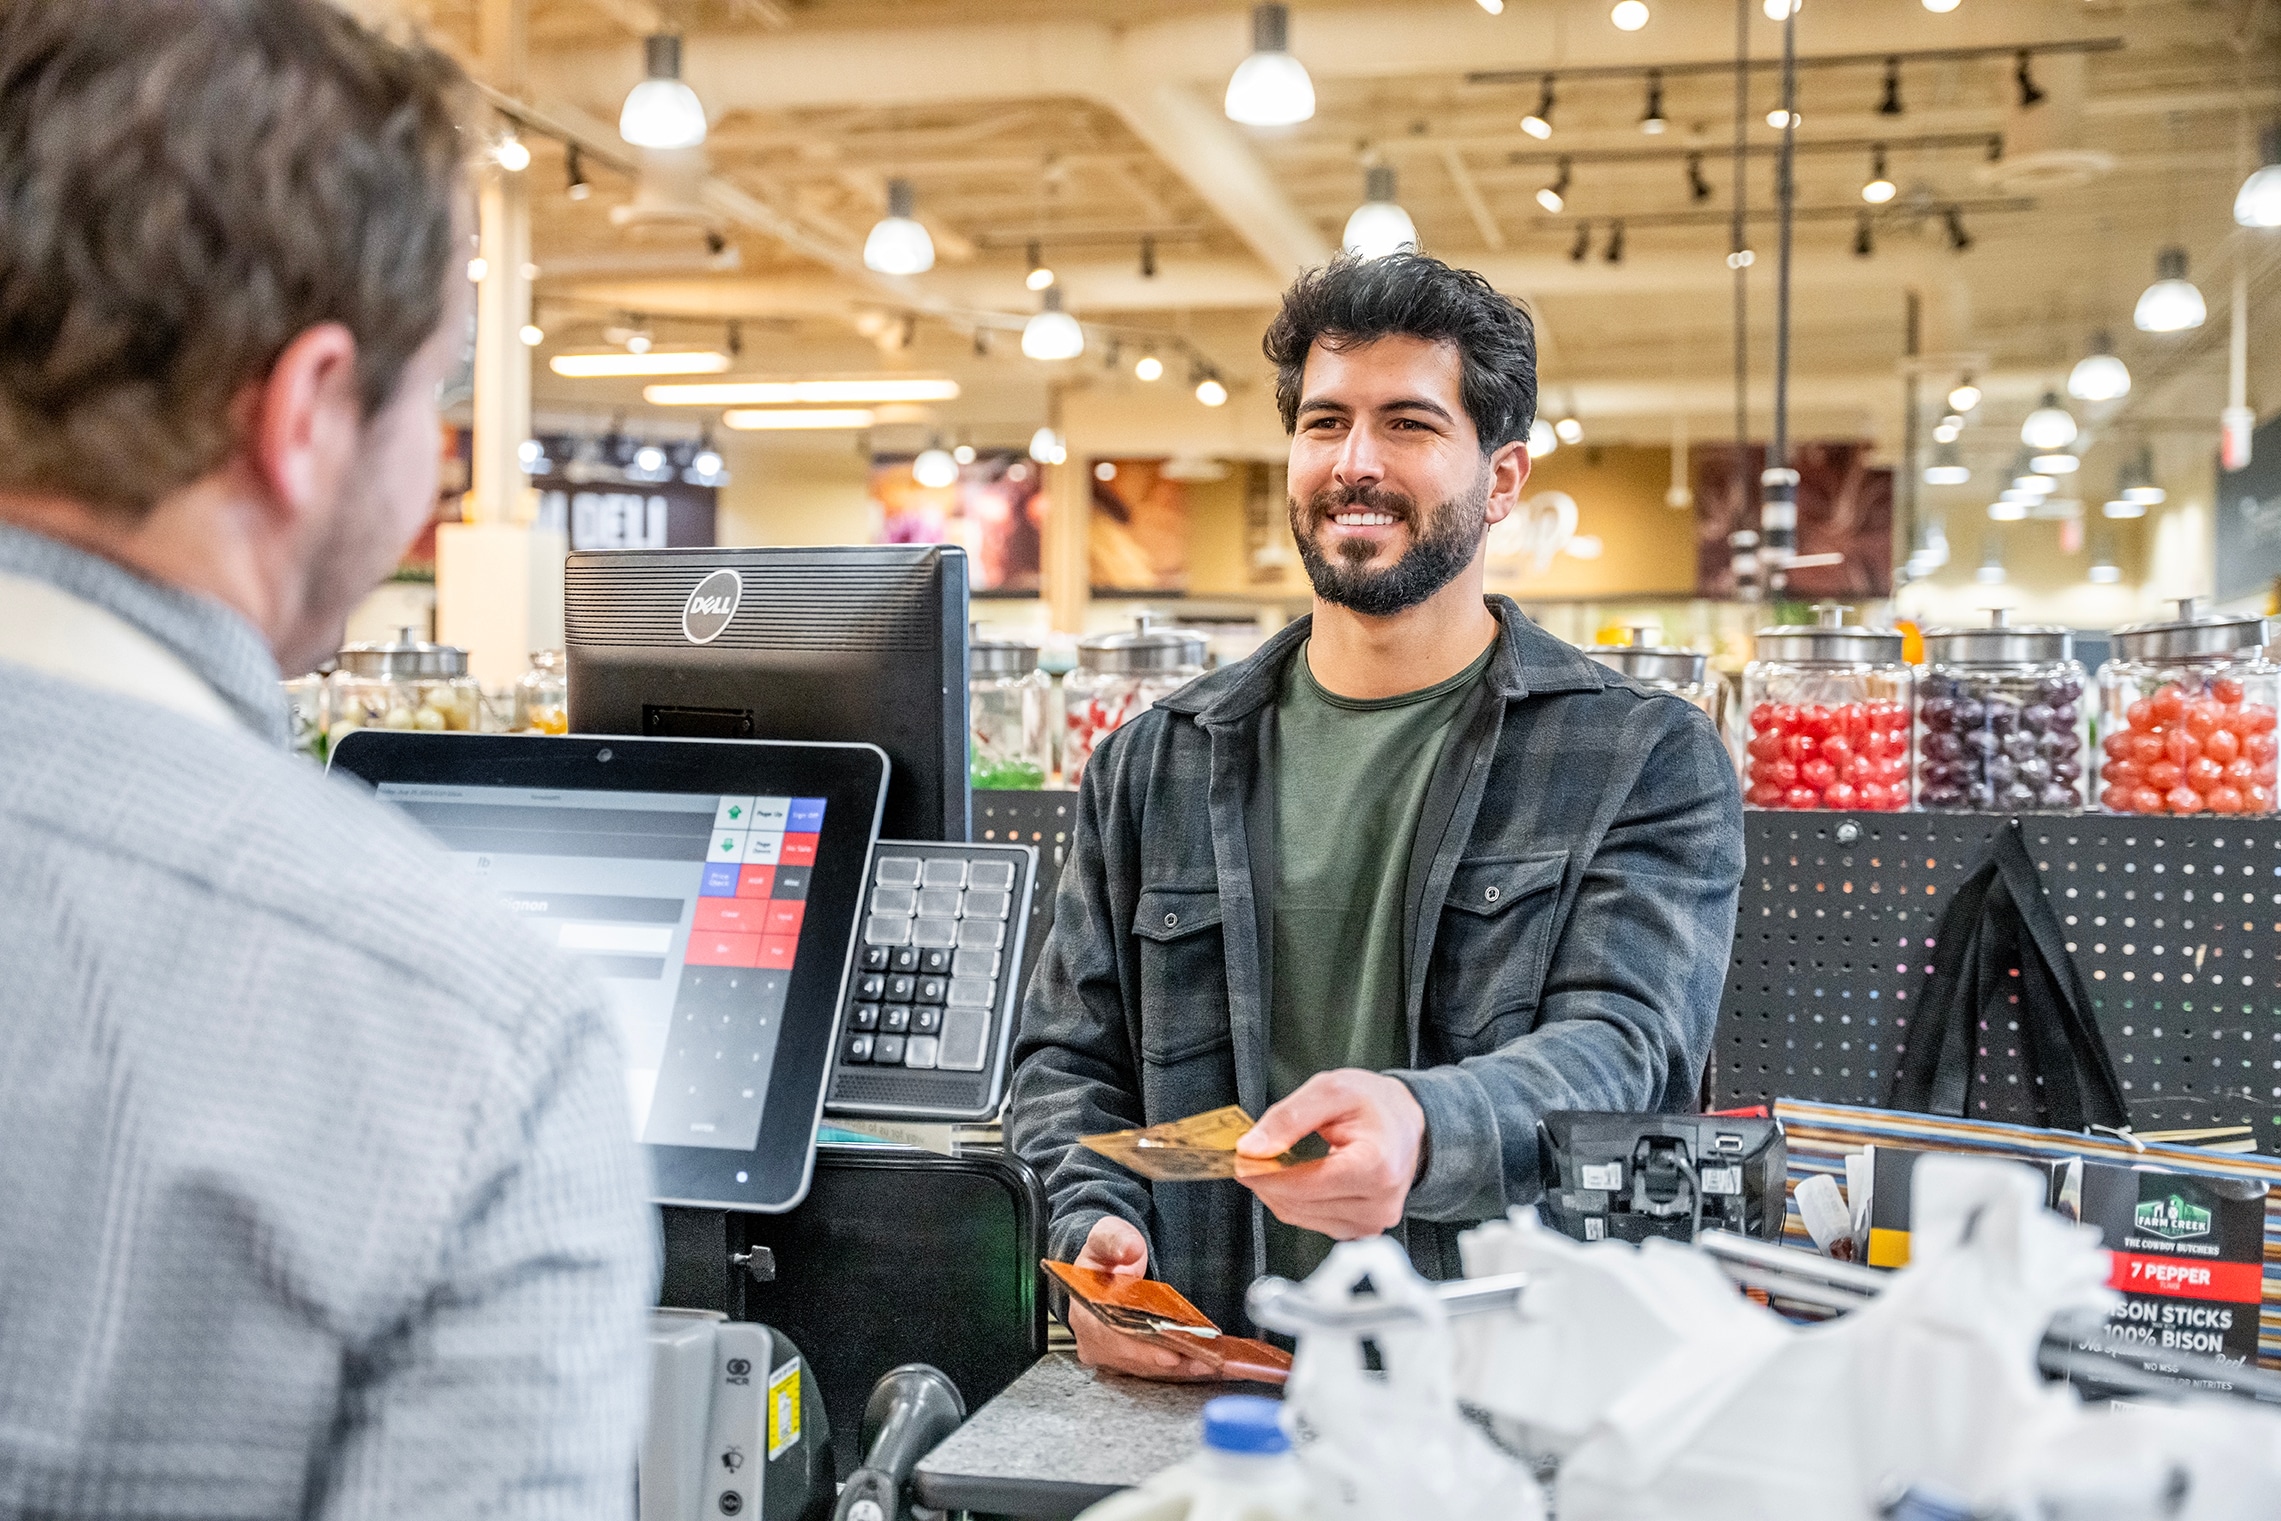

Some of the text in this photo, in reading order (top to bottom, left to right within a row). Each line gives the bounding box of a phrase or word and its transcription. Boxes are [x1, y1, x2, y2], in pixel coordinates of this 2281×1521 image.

[571, 491, 668, 549] DELI
[690, 595, 731, 615] DELL
[871, 950, 941, 966] 7 8 9
[864, 980, 937, 996] 4 5 6
[859, 1009, 931, 1026] 1 2 3
[852, 1040, 864, 1054] 0
[2139, 1216, 2168, 1228] FARM
[2171, 1219, 2206, 1231] CREEK
[2124, 1237, 2220, 1256] THE COWBOY BUTCHERS
[2131, 1262, 2211, 1285] 7 PEPPER
[2110, 1301, 2233, 1330] ISON STICKS
[2104, 1323, 2156, 1347] 100%
[2162, 1330, 2223, 1352] BISON
[2143, 1361, 2179, 1373] NO MSG
[2192, 1379, 2233, 1391] NITRITES
